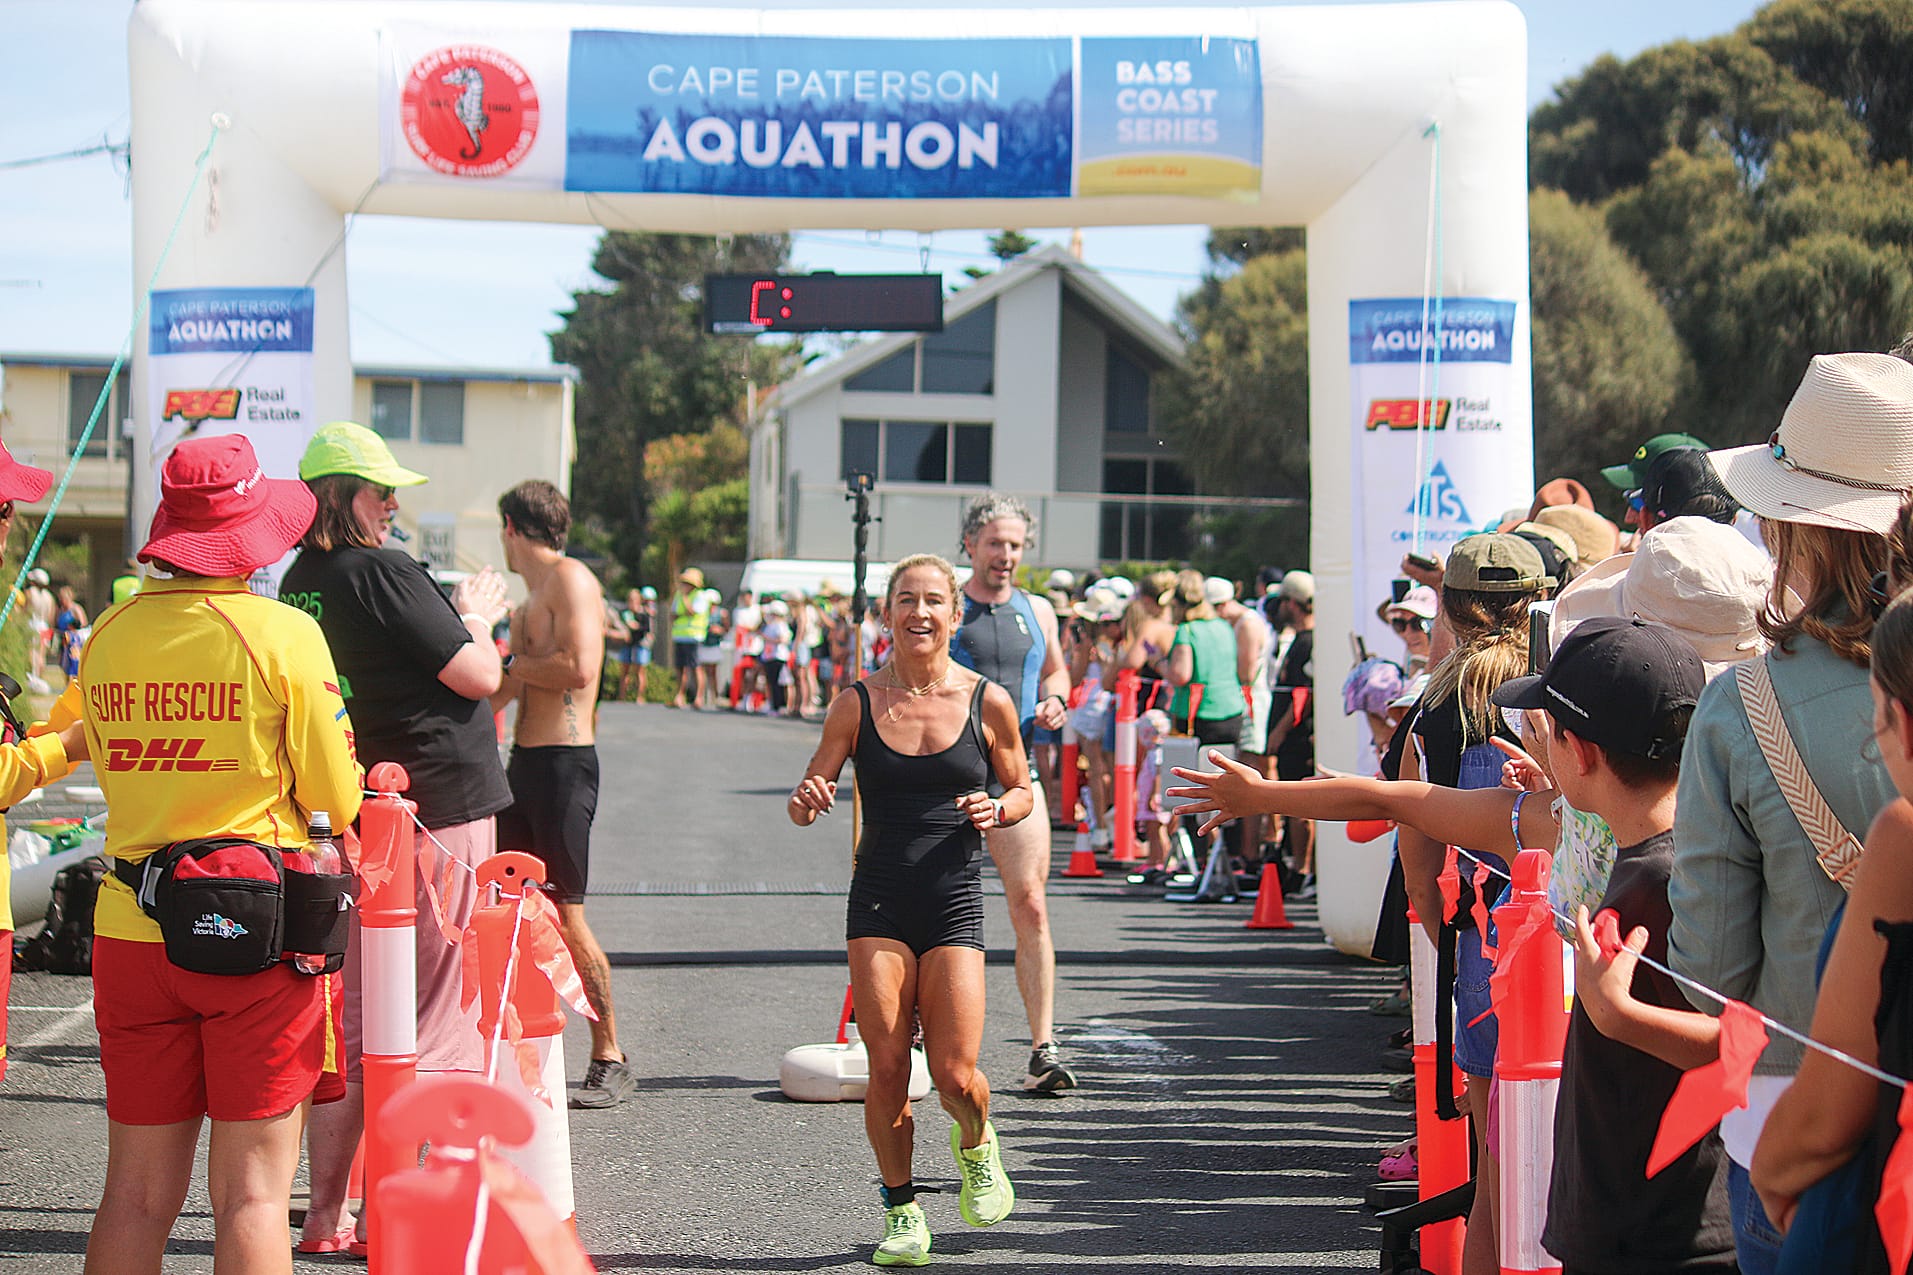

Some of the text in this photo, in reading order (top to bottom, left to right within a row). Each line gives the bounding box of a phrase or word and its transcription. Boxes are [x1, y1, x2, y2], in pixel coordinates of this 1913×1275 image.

[648, 64, 999, 100] CAPE PATERSON
[1116, 60, 1192, 84] BASS
[1116, 88, 1218, 112] COAST
[1117, 118, 1218, 143] SERIES
[642, 116, 999, 170] AQUATHON
[169, 300, 291, 315] CAPE PATERSON
[168, 319, 293, 342] AQUATHON
[1371, 329, 1496, 351] AQUATHON
[247, 386, 285, 401] Real
[1456, 397, 1490, 411] Real
[247, 405, 301, 420] Estate
[1456, 416, 1503, 431] Estate
[90, 682, 243, 722] SURF RESCUE
[107, 738, 213, 772] DHL
[194, 920, 213, 928] Saving
